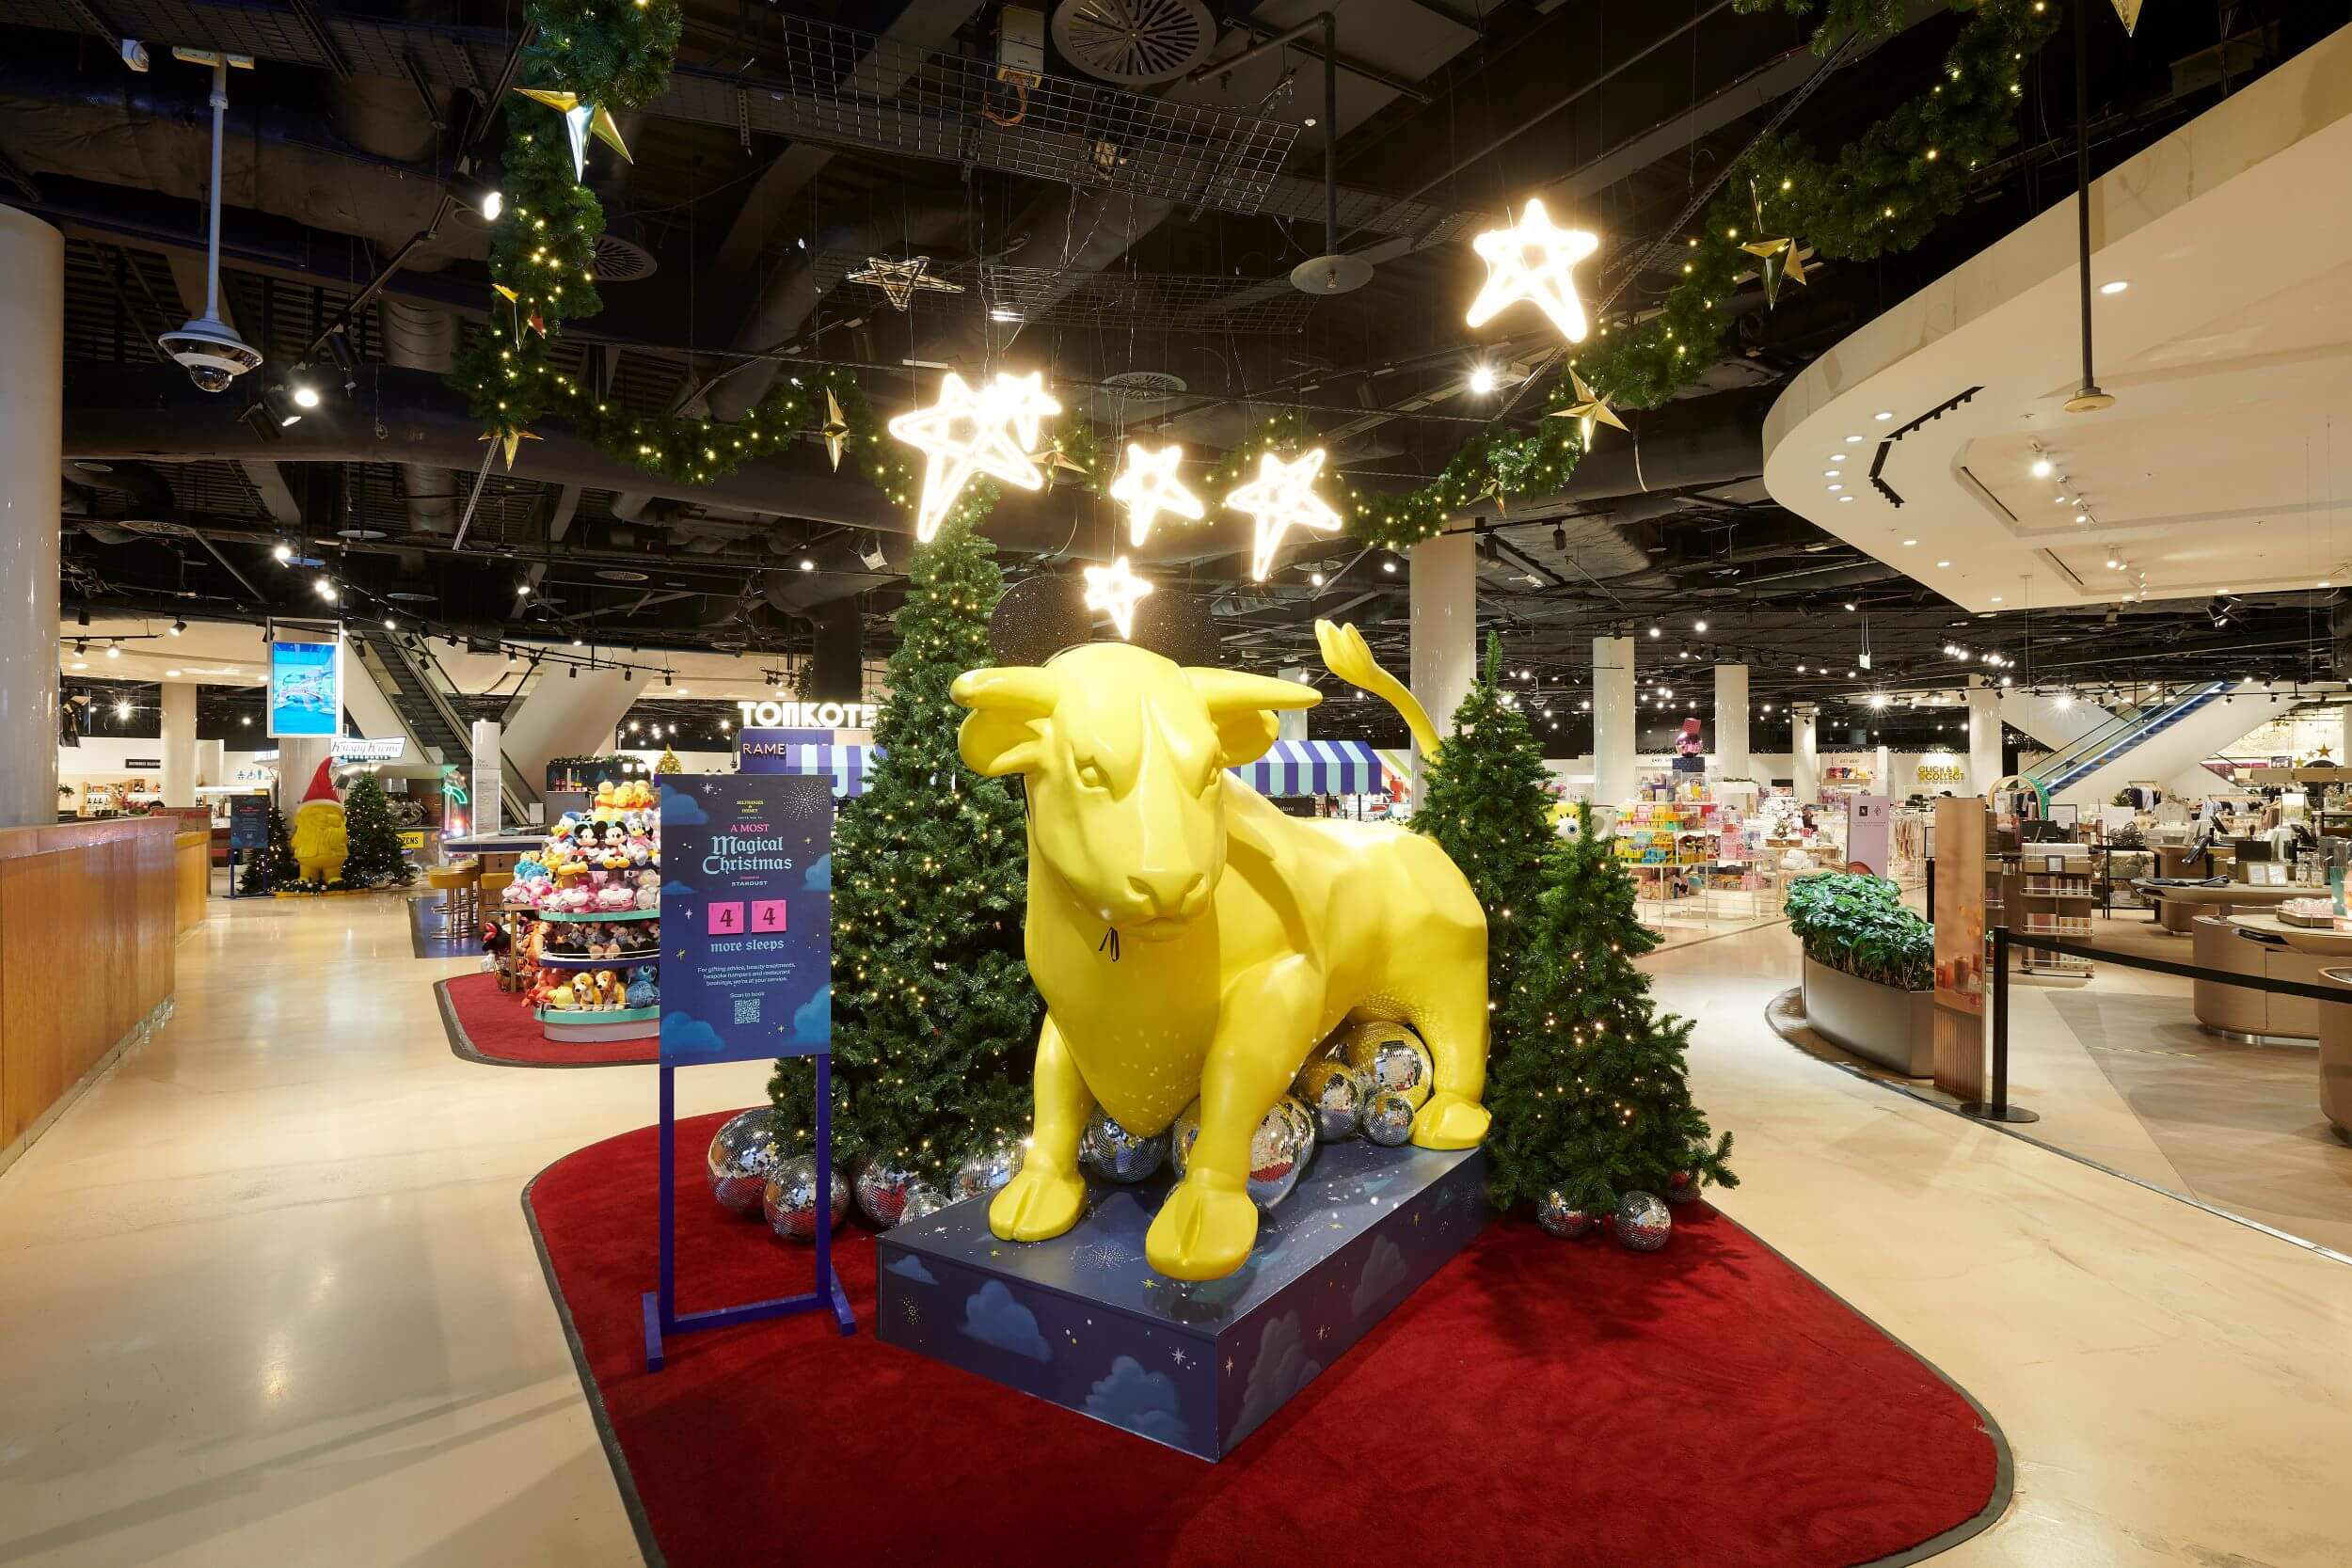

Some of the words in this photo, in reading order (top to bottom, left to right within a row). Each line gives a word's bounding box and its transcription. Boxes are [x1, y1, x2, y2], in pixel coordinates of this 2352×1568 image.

[743, 743, 795, 754] RAME
[1926, 772, 1964, 781] COLLECT
[730, 824, 738, 832] A
[740, 824, 770, 832] MOST
[710, 835, 784, 855] Magical
[702, 856, 793, 875] Christmas
[720, 909, 733, 927] 4
[762, 907, 776, 926] 4
[710, 942, 742, 953] more
[745, 940, 785, 952] sleeps
